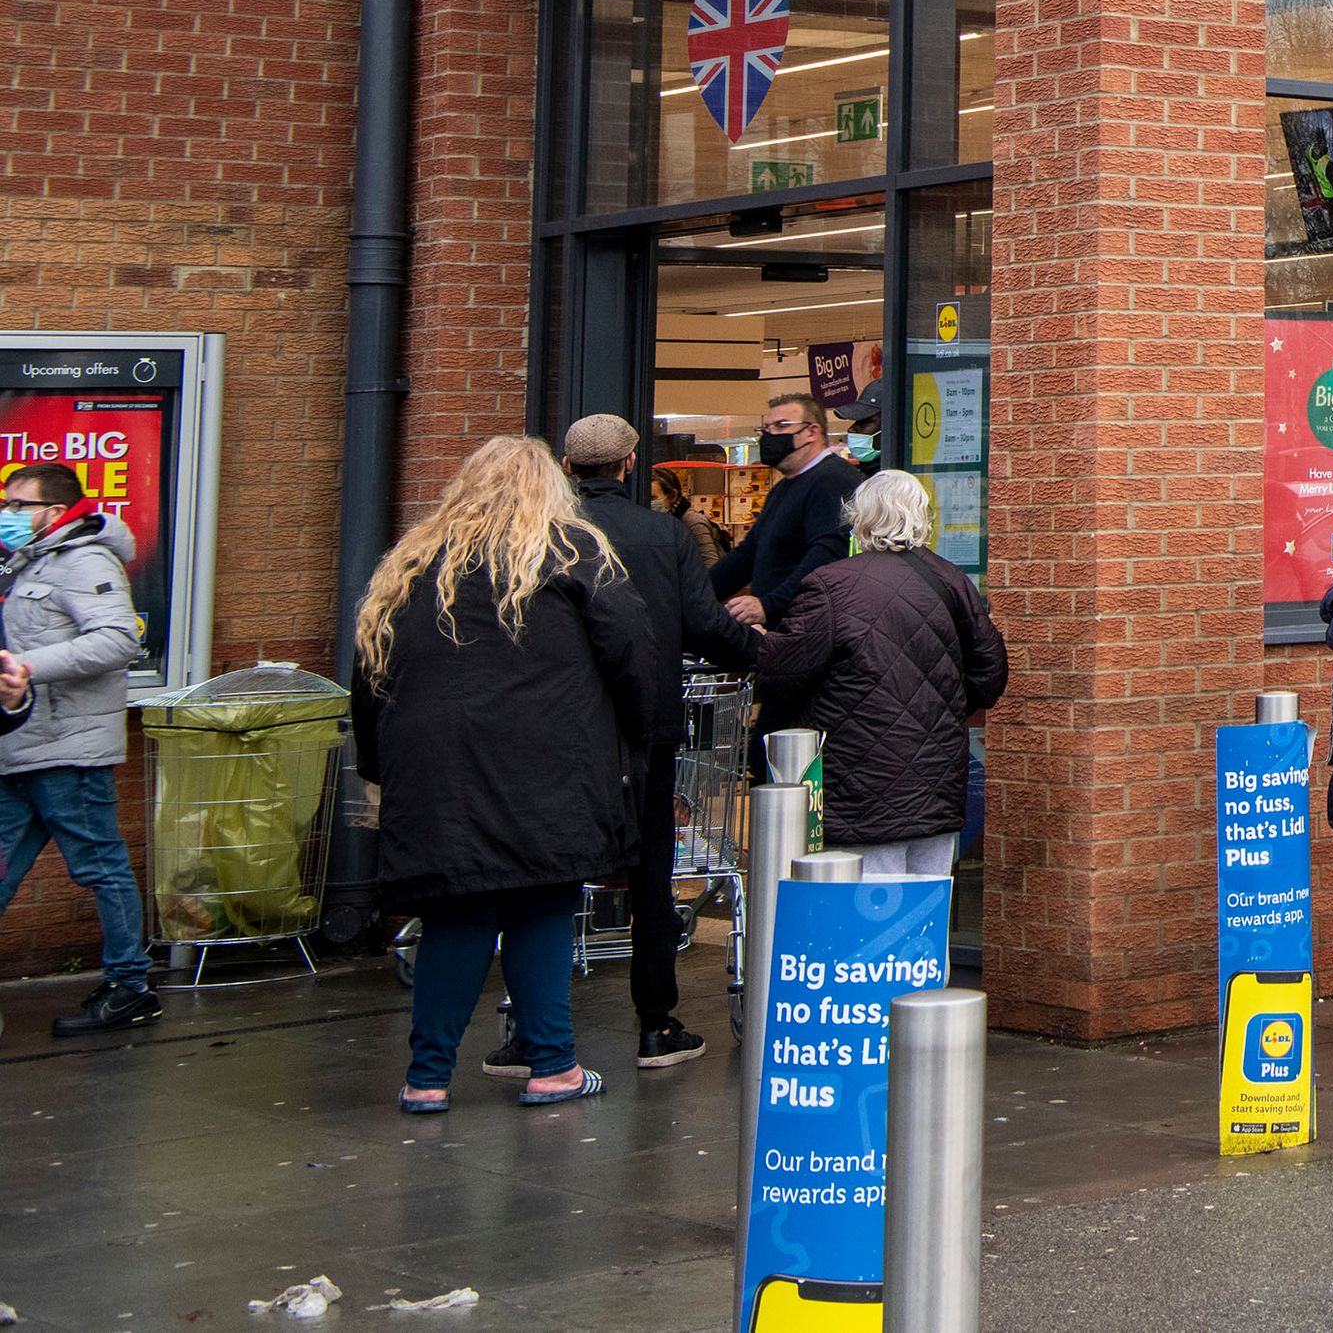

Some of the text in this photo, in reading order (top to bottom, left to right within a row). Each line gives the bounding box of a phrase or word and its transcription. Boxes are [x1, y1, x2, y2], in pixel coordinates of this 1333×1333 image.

[22, 363, 119, 378] Upcoming offers
[815, 354, 849, 379] Big on
[0, 431, 128, 460] The BIG
[0, 462, 128, 498] LE
[1309, 468, 1332, 479] Have
[1300, 483, 1327, 496] Merry
[1225, 771, 1257, 793] Big
[1225, 795, 1294, 815] no fuss,
[1225, 815, 1305, 841] that's Lidl
[1225, 847, 1270, 867] Plus
[1227, 887, 1309, 907] Our brand new
[1227, 910, 1282, 927] rewards
[780, 953, 942, 990] Big savings,
[776, 996, 889, 1027] no fuss,
[773, 1036, 890, 1066] that's Li
[1261, 1063, 1289, 1078] Plus
[770, 1077, 836, 1108] Plus
[1240, 1092, 1300, 1103] Download and
[1231, 1104, 1252, 1113] start
[1255, 1104, 1283, 1115] saving
[765, 1149, 803, 1172] Our
[810, 1149, 875, 1173] brand
[762, 1182, 847, 1205] rewards
